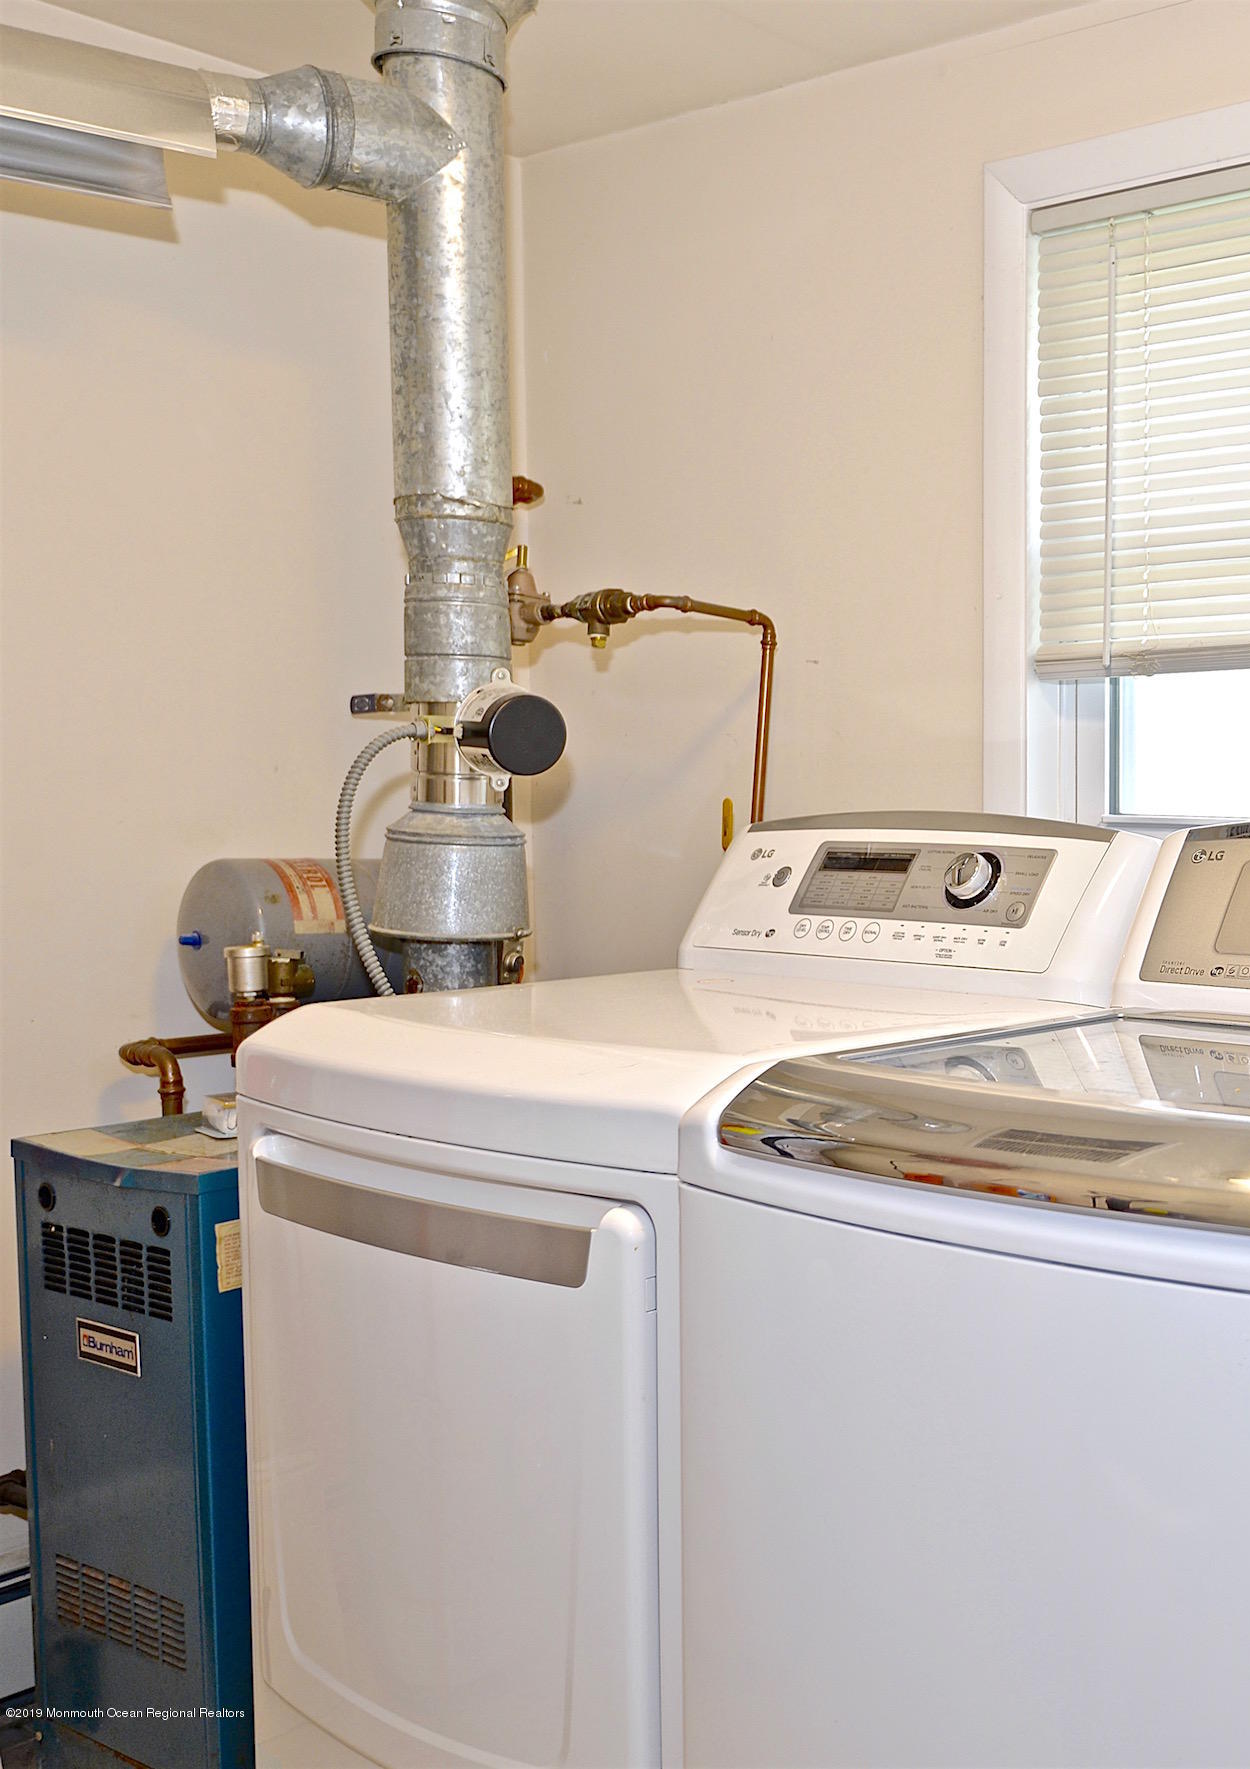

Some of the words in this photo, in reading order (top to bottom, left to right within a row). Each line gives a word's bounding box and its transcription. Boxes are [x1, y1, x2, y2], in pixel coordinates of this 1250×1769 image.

[1207, 851, 1225, 861] LG
[732, 928, 751, 936] Sensor
[751, 930, 762, 939] Dry
[1160, 965, 1184, 974] Direct
[1184, 967, 1205, 977] Drive
[88, 1336, 134, 1360] Burnham
